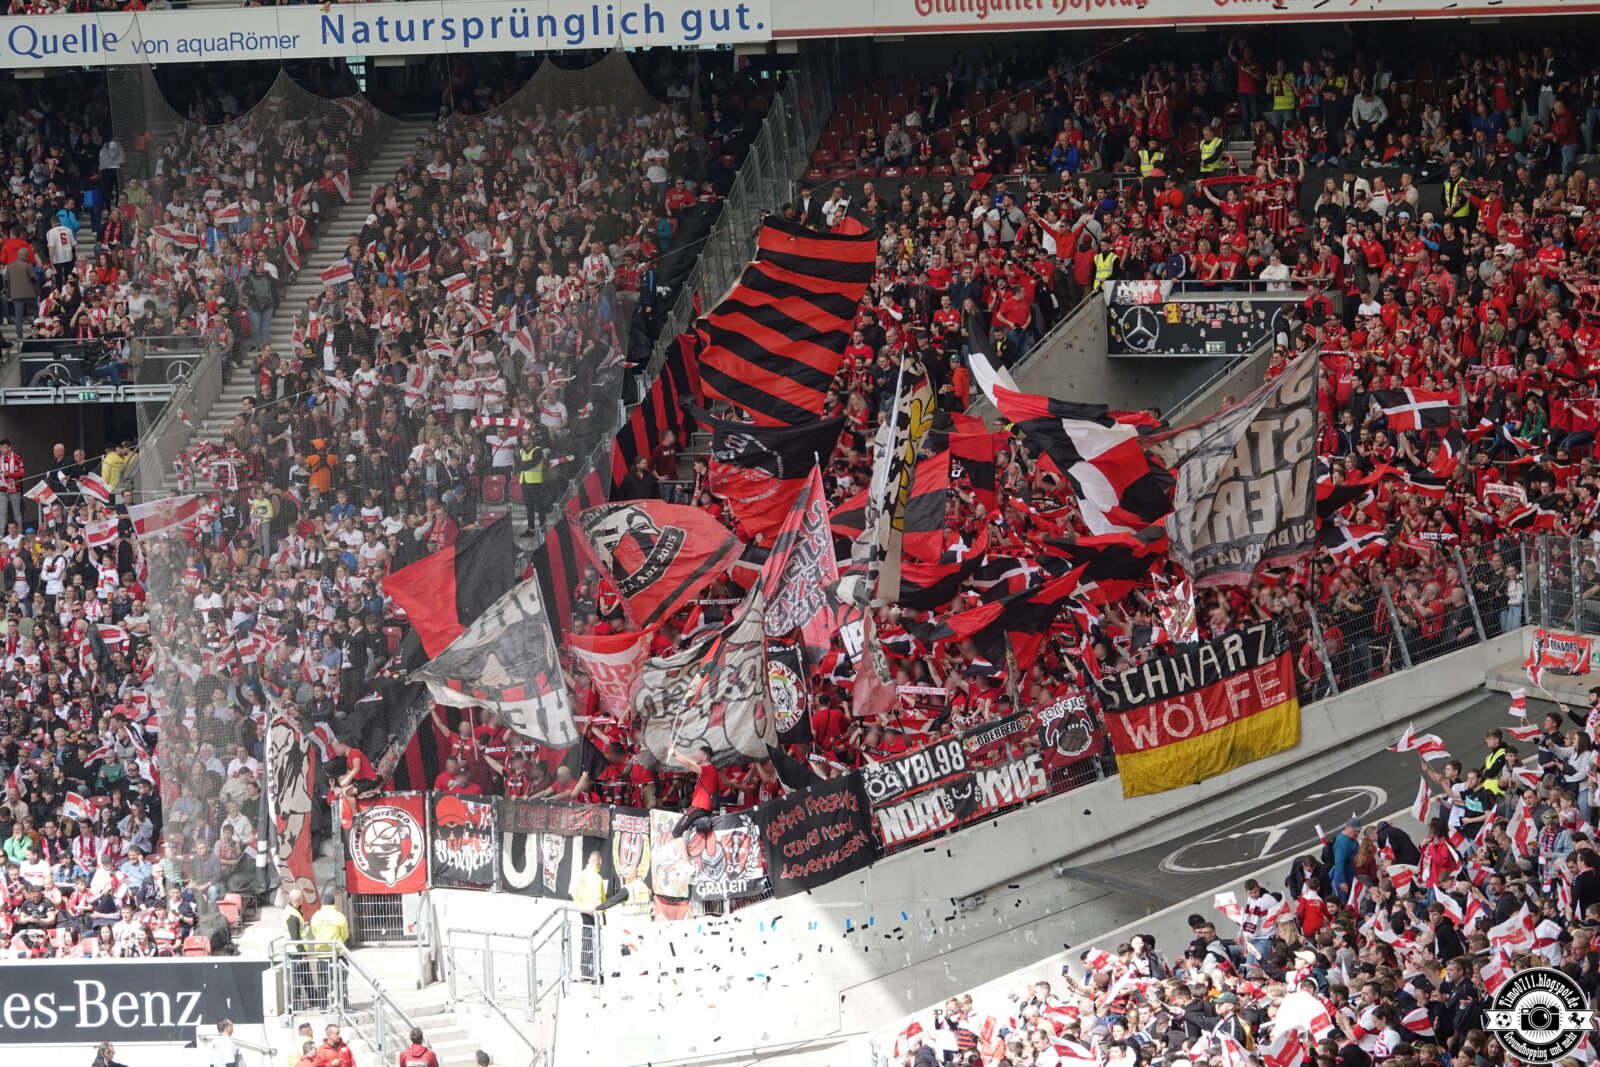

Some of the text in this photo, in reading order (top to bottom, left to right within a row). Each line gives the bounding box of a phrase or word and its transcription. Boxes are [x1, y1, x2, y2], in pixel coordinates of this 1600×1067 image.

[8, 23, 300, 59] Quelle von aquaRömer
[321, 3, 765, 48] Natursprünglich gut.
[656, 533, 678, 564] 2005
[1119, 661, 1286, 750] WÖLFE
[976, 718, 1024, 746] OBERBERG
[895, 740, 965, 788] YBL98
[875, 787, 955, 844] NORD
[0, 979, 202, 1029] es-Benz
